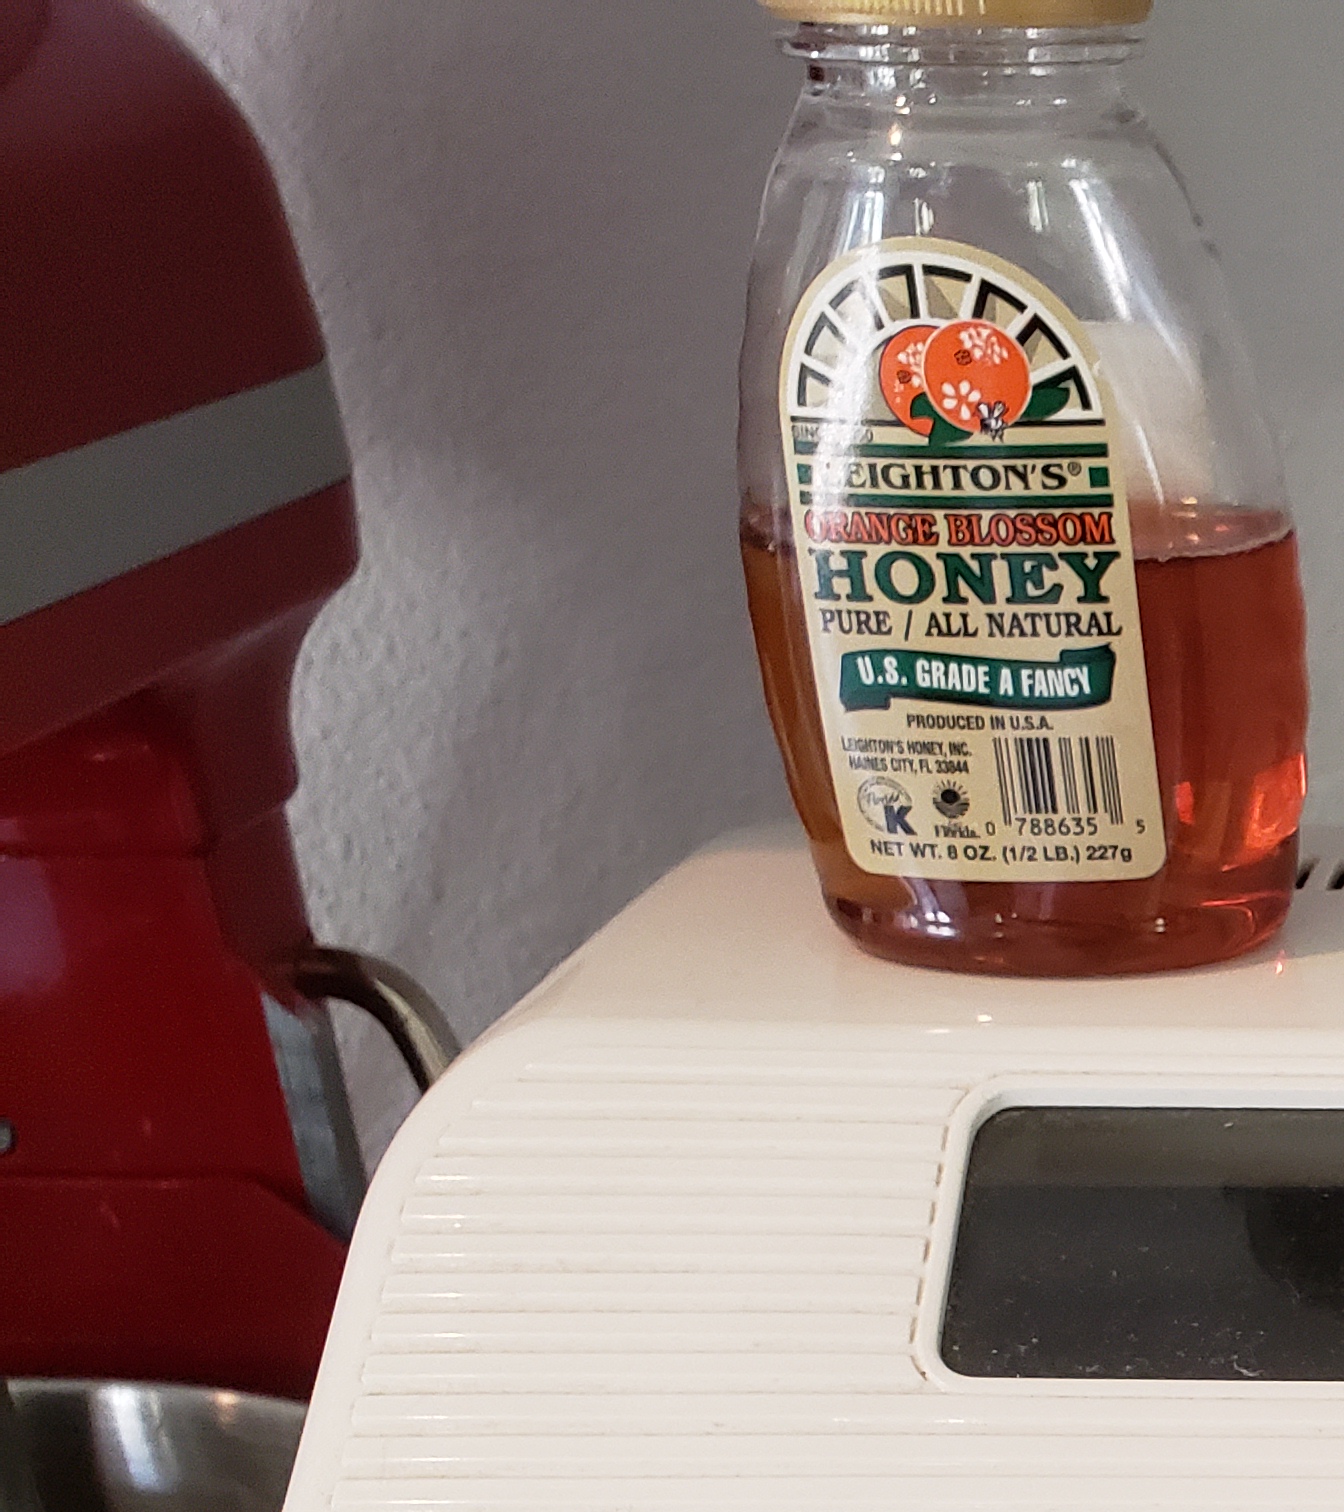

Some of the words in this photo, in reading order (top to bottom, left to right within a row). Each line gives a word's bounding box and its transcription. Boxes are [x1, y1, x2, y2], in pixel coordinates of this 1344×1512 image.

[805, 509, 939, 546] ORANGE
[945, 512, 1115, 547] BLOSSOM
[808, 549, 1121, 605] HONEY
[822, 609, 892, 636] PURE
[925, 611, 978, 637] ALL
[988, 611, 1122, 638] NATURAL
[856, 655, 908, 686] U.S.
[916, 658, 990, 695] GRADE
[999, 666, 1015, 696] A
[1021, 666, 1091, 698] FANCY
[906, 713, 985, 731] PRODUCED
[990, 714, 1005, 731] IN
[1009, 714, 1054, 731] U.S.A.
[907, 740, 948, 757] HONEY,
[949, 741, 972, 757] INC.
[849, 756, 888, 772] HAINES
[891, 758, 918, 775] CITY,
[919, 759, 933, 774] FL
[884, 805, 918, 836] K
[985, 821, 996, 837] 0
[1015, 817, 1099, 837] 788635
[1136, 819, 1146, 835] 5
[870, 840, 904, 857] NET
[909, 843, 942, 860] WT.
[947, 844, 958, 860] 8
[963, 845, 997, 861] OZ.
[1002, 846, 1038, 865] (1/2
[1043, 846, 1080, 865] LB.)
[1086, 844, 1132, 863] 227g
